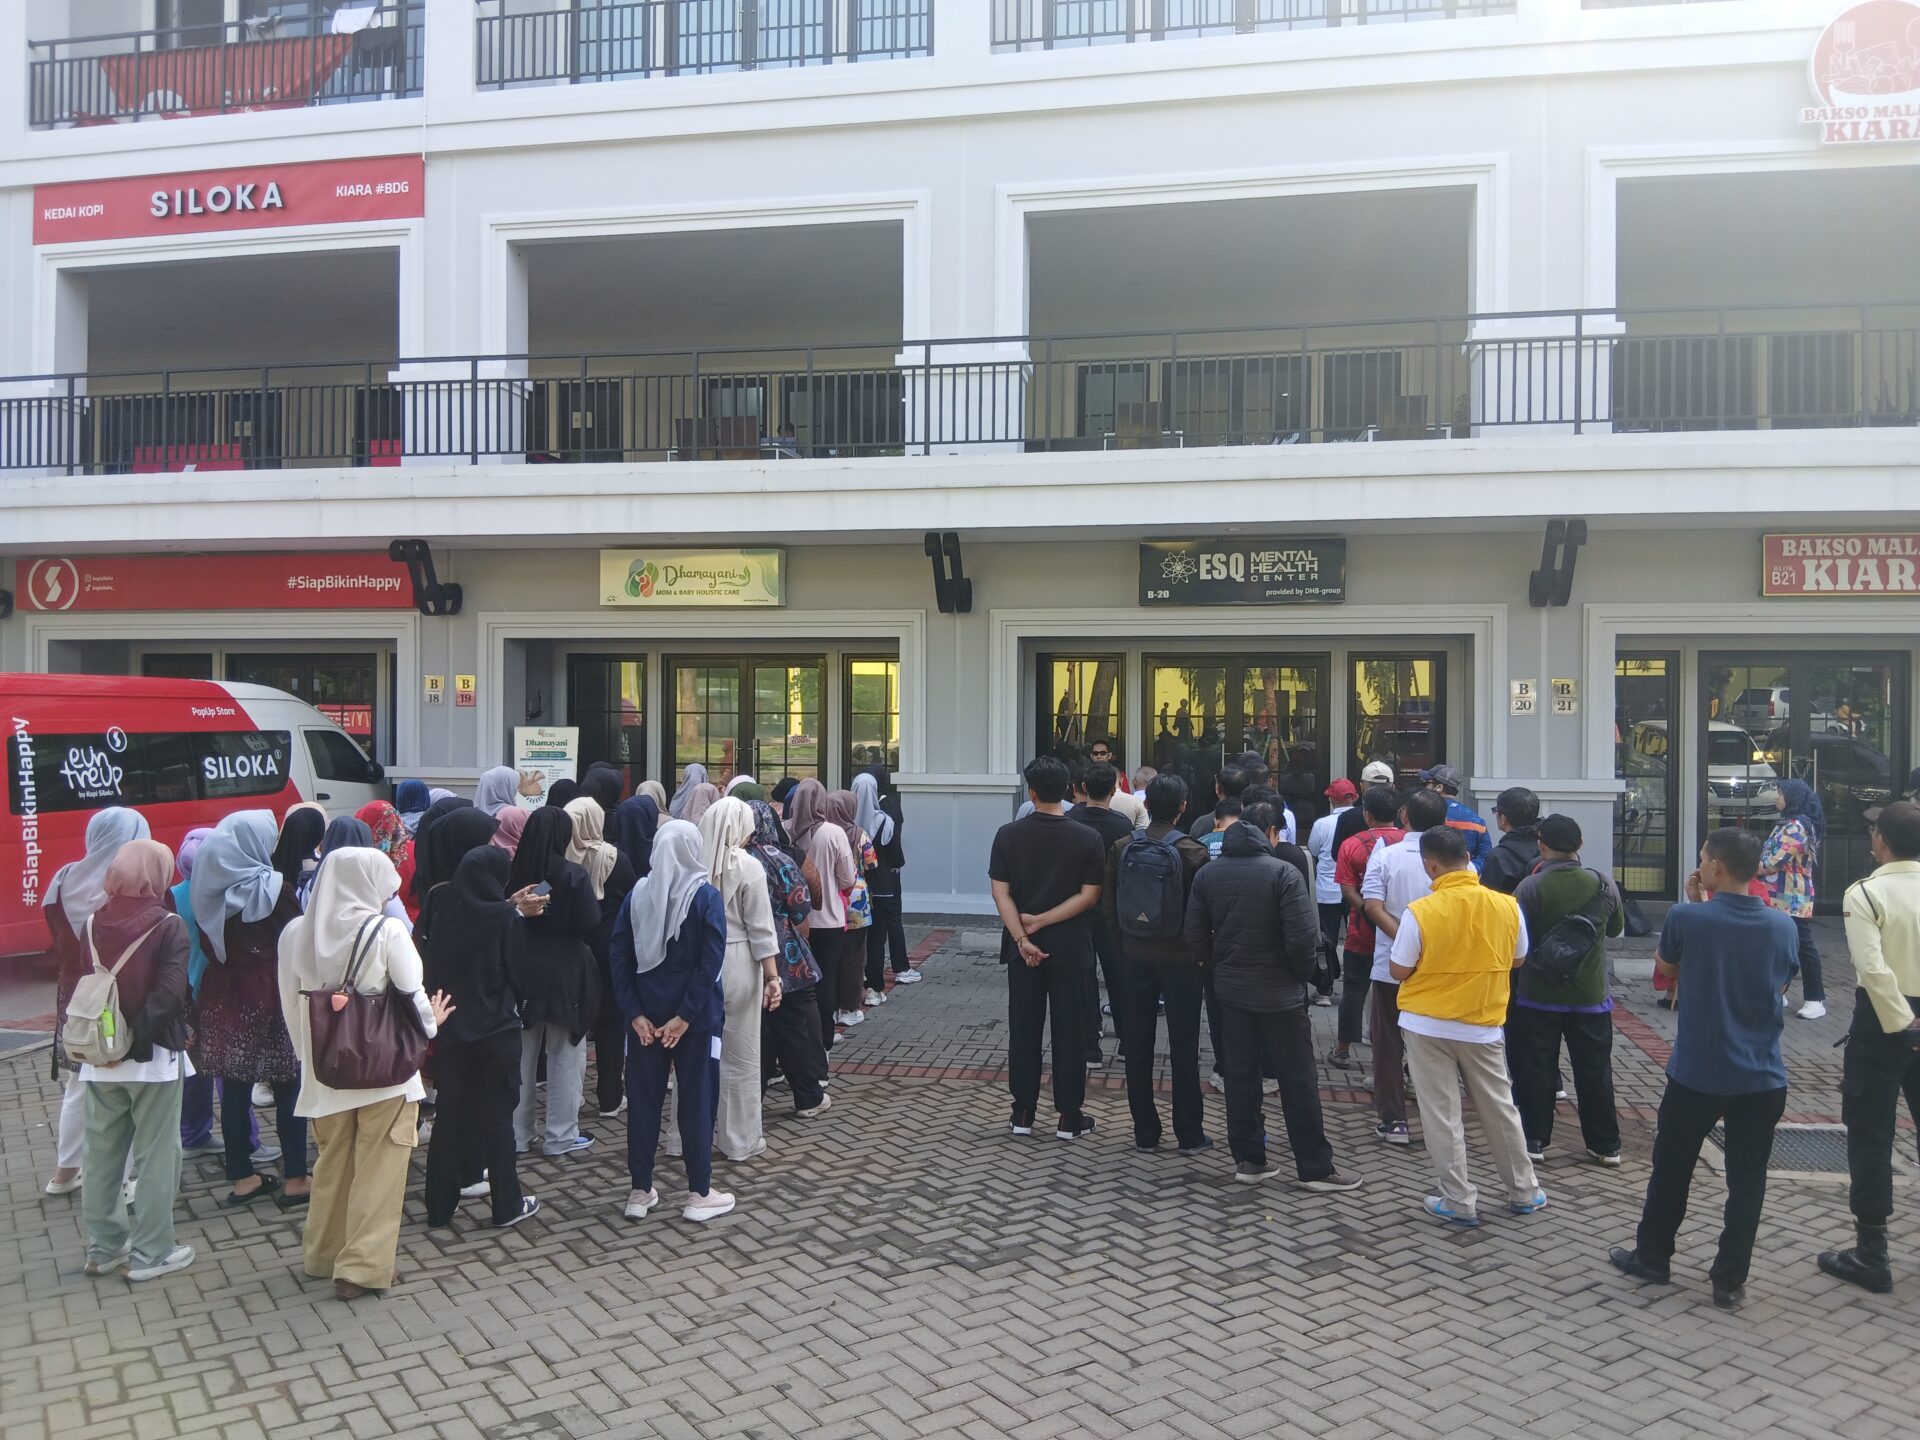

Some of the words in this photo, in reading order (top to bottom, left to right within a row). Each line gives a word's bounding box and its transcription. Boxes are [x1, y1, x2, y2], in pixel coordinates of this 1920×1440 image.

[1804, 107, 1868, 121] BAKSO
[1873, 104, 1920, 119] MAL
[336, 184, 372, 197] KIARA
[375, 181, 409, 195] #BDG
[150, 182, 283, 217] SILOKA
[44, 207, 76, 220] KEDAI
[78, 204, 104, 217] KOPI
[1782, 538, 1862, 557] BAKSO
[1867, 538, 1920, 556] MAL
[1250, 550, 1318, 562] MENTAL
[1200, 552, 1245, 583] ESQ
[1250, 561, 1318, 573] HEALTH
[662, 564, 738, 588] Dhamayani
[1250, 573, 1318, 582] CENTER
[1772, 571, 1796, 586] B21
[1802, 558, 1920, 591] KIAR
[287, 575, 401, 592] #SiapBikinHappy
[724, 588, 740, 596] CARE
[1147, 589, 1170, 599] B-20
[1295, 588, 1303, 596] by
[430, 679, 438, 689] B
[462, 679, 470, 689] B
[1519, 683, 1529, 695] B
[1560, 683, 1571, 695] B
[428, 694, 440, 703] 18
[460, 694, 472, 703] 19
[1515, 700, 1532, 711] 20
[1557, 700, 1573, 711] 21
[191, 707, 215, 718] PopUp
[216, 706, 236, 716] Store
[526, 739, 568, 747] Dhamayani
[204, 754, 279, 780] SILOKA
[79, 791, 86, 799] by
[86, 790, 98, 799] Kopi
[12, 716, 43, 906] #SiapBikinHappy
